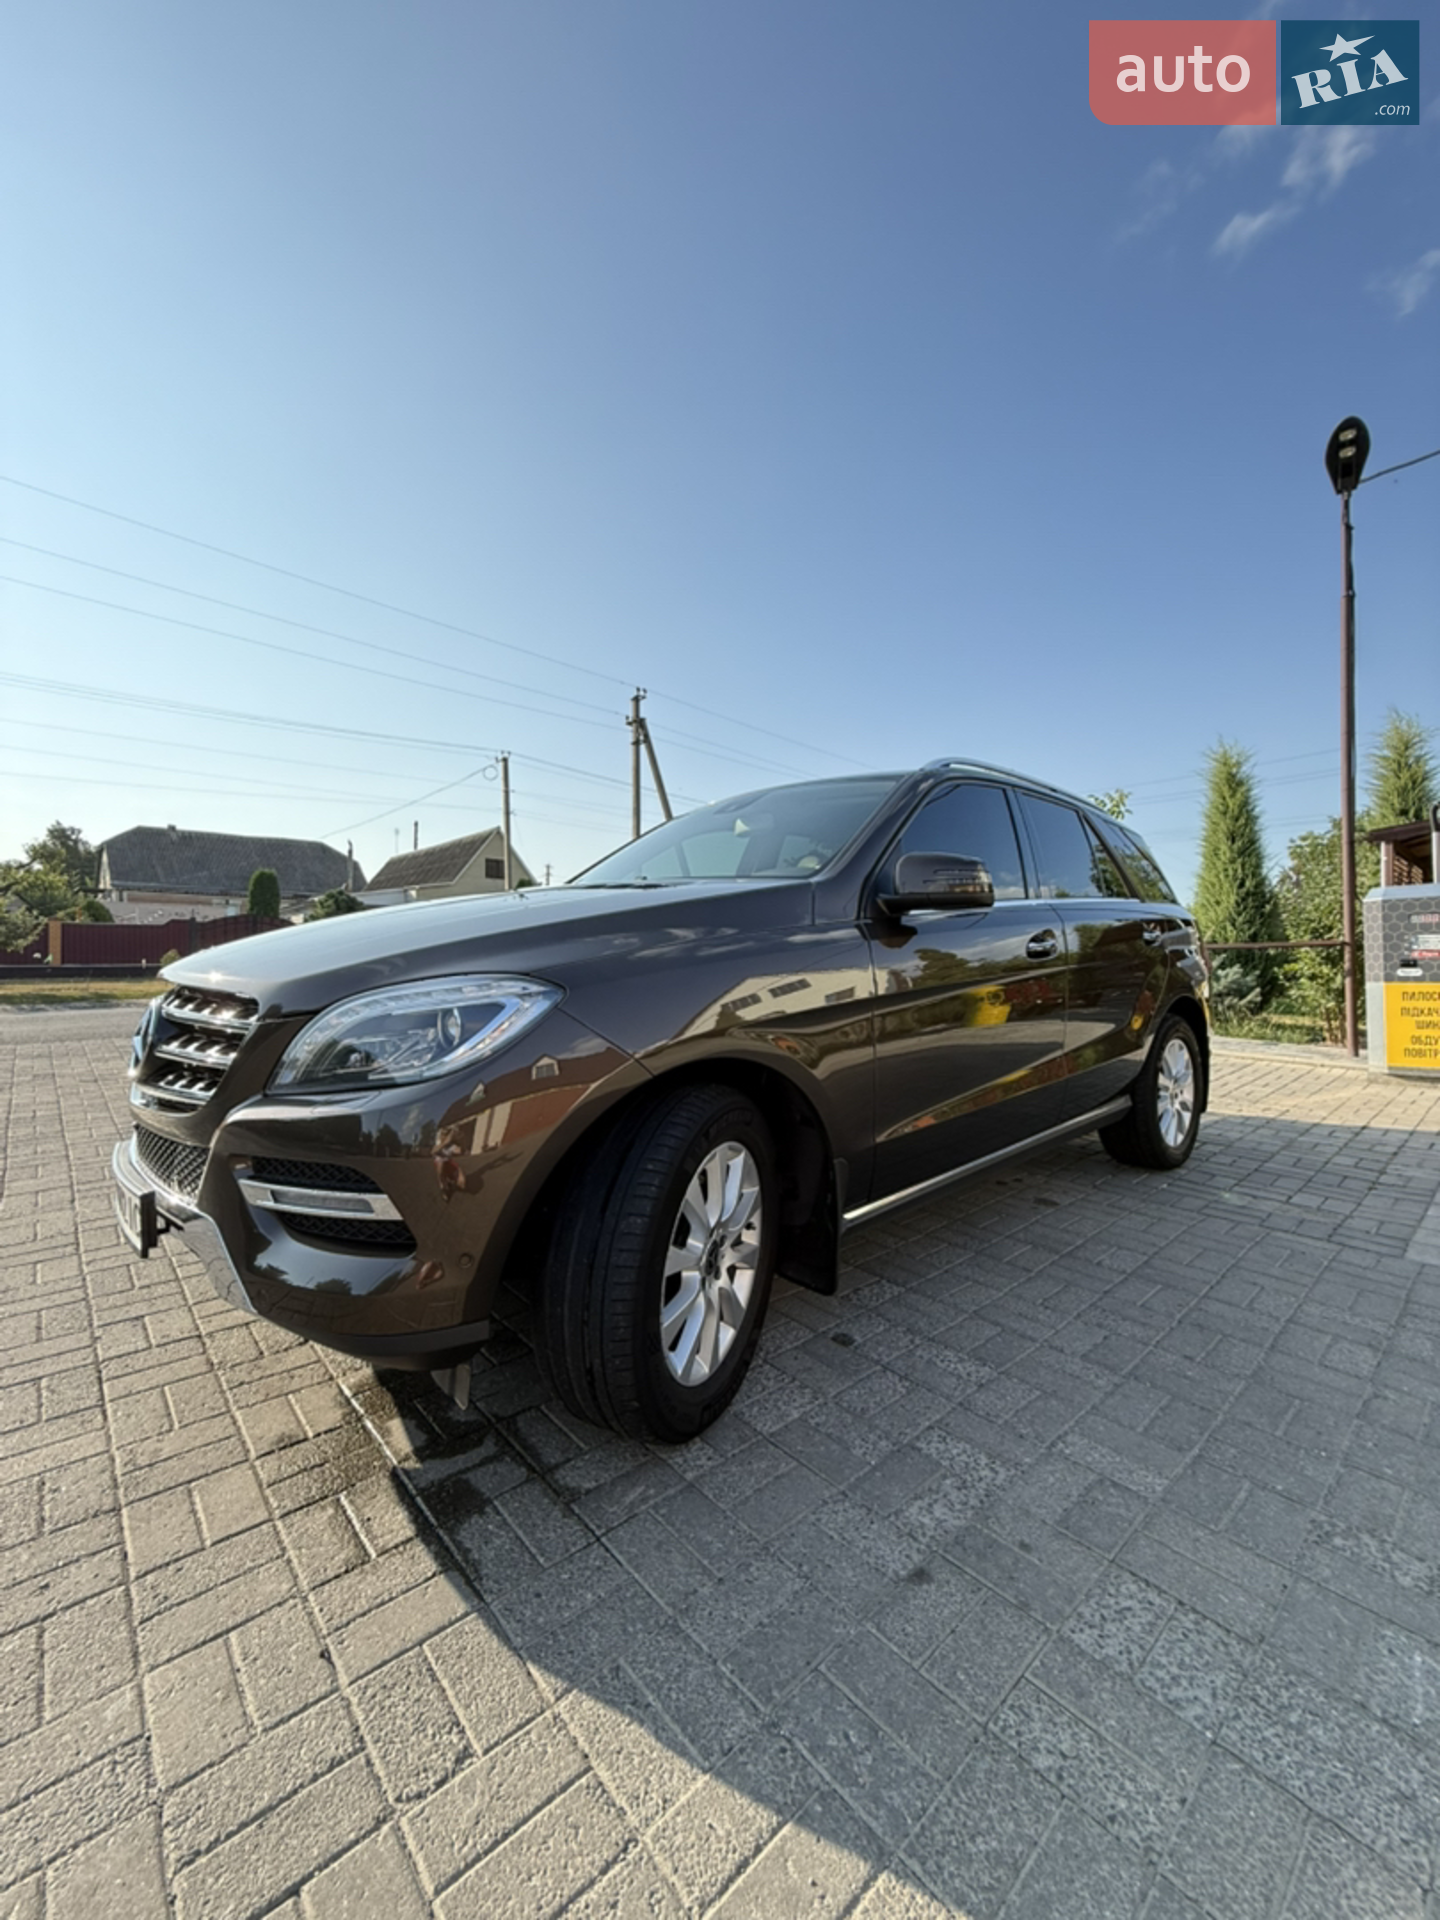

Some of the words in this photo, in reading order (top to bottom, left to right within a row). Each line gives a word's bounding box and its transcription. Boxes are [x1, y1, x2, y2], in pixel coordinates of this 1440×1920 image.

[1400, 1006, 1440, 1018] ПІДКАЧ
[1415, 1020, 1440, 1030] ШИН
[1411, 1034, 1440, 1046] ОБДУ
[1404, 1047, 1440, 1059] ПОВІТР
